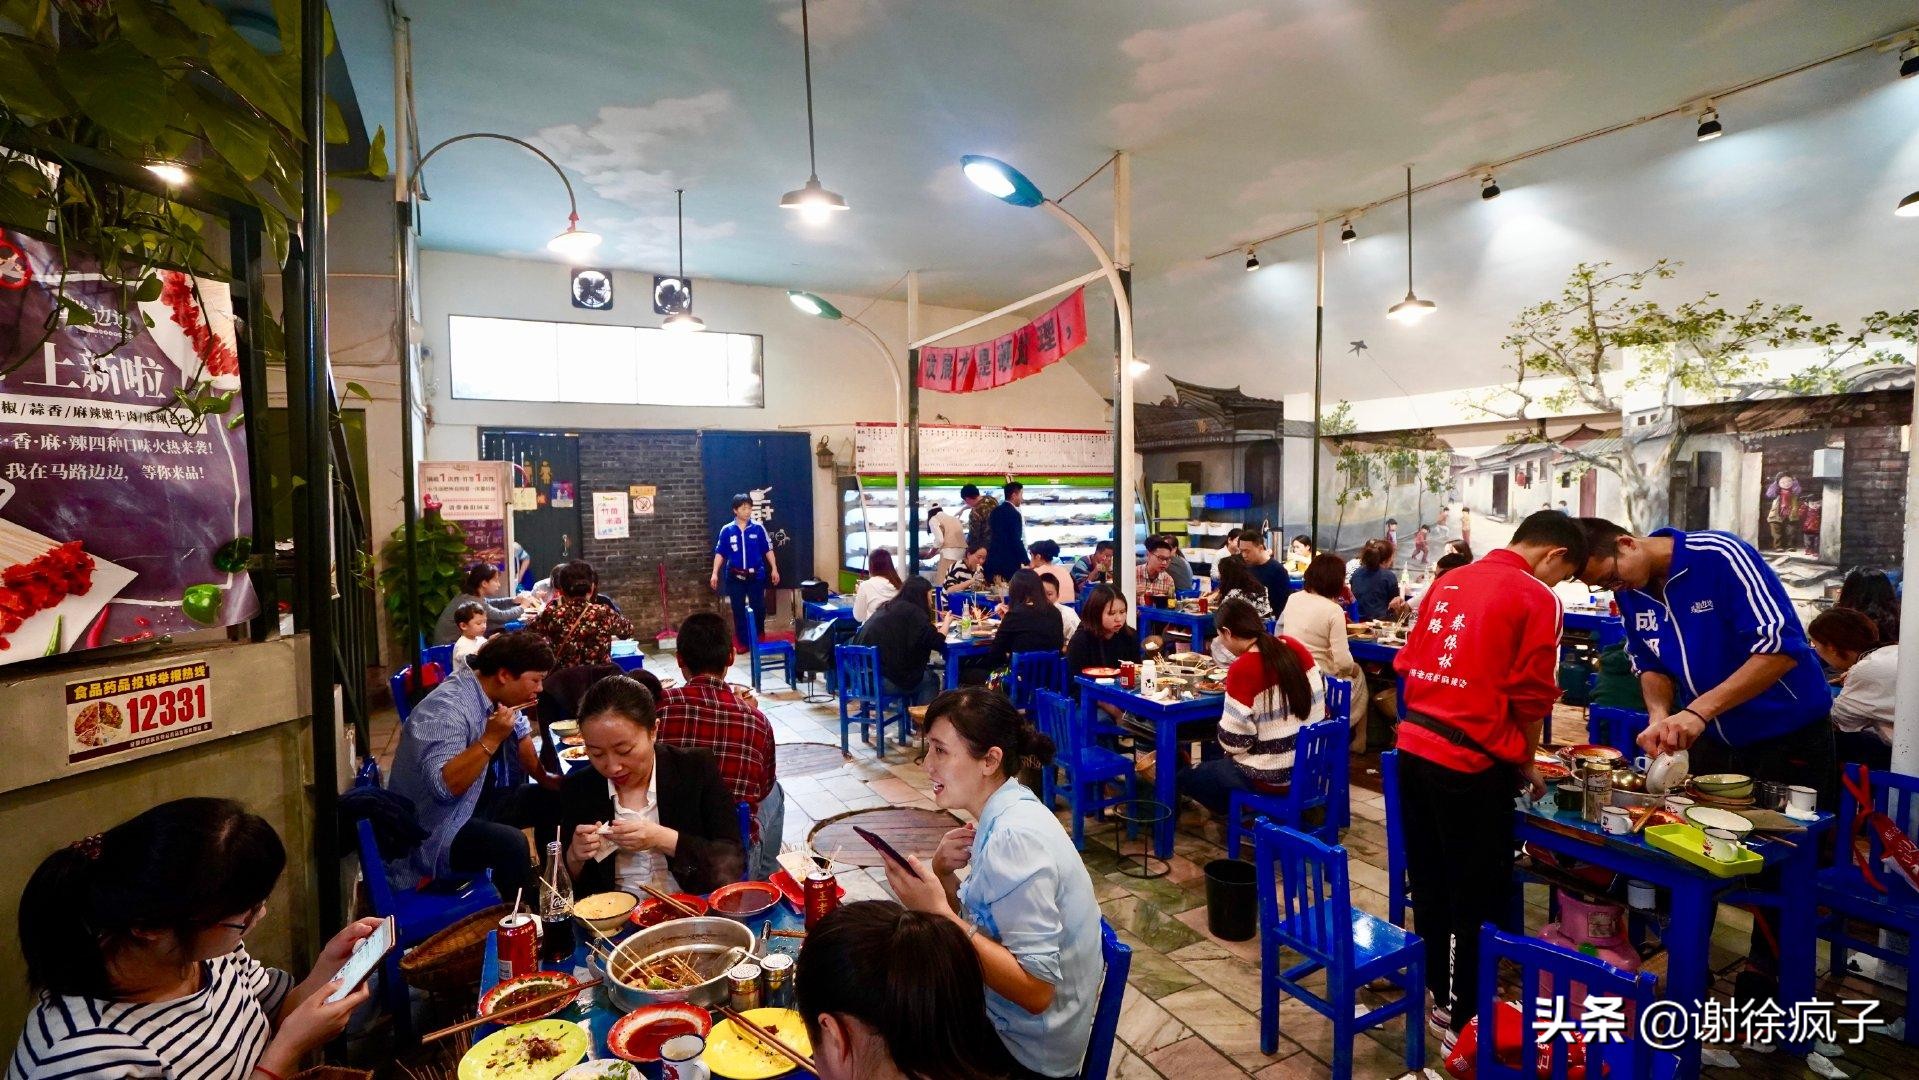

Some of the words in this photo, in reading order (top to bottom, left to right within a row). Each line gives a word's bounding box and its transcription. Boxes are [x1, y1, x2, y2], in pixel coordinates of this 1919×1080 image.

[23, 341, 167, 399] 上新啦
[0, 432, 213, 455] ·香·麻·辣四种口味火热来袭！
[74, 664, 206, 700] 食品药品投诉举报热线
[127, 684, 206, 734] 12331
